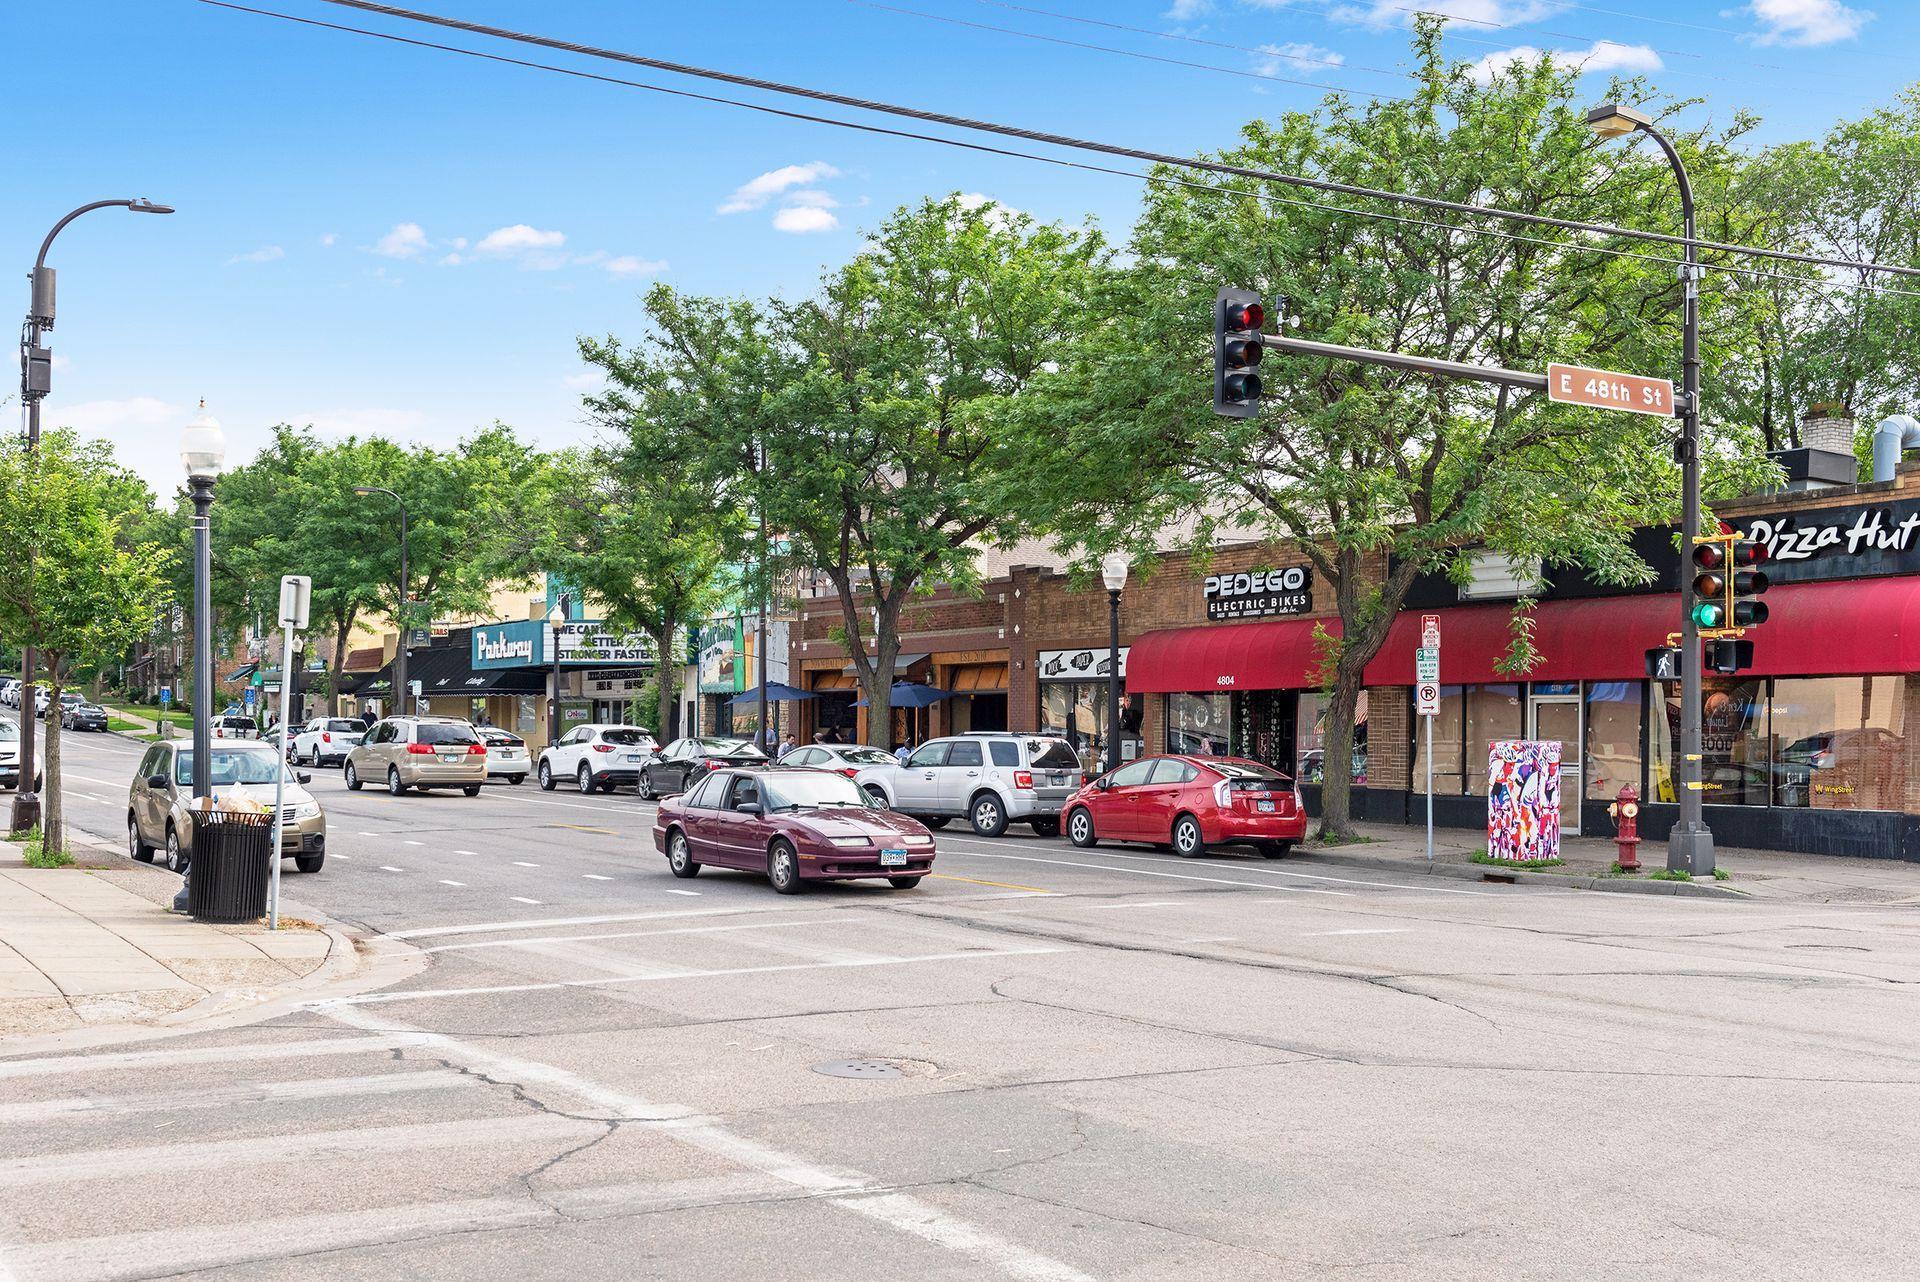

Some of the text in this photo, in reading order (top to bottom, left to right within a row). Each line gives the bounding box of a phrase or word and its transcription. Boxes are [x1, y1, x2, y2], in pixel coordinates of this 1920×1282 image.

[1560, 374, 1662, 407] E 48th St
[1748, 510, 1920, 560] Pizza Hut
[1203, 568, 1304, 598] PEDEGO
[1210, 595, 1306, 613] ELECTRIC BIKES
[477, 631, 532, 663] Parkway
[584, 637, 624, 647] ETTER
[559, 649, 611, 660] STRONGER
[1418, 651, 1424, 660] 2
[1217, 675, 1235, 685] 4804
[1824, 785, 1855, 795] WingStreet
